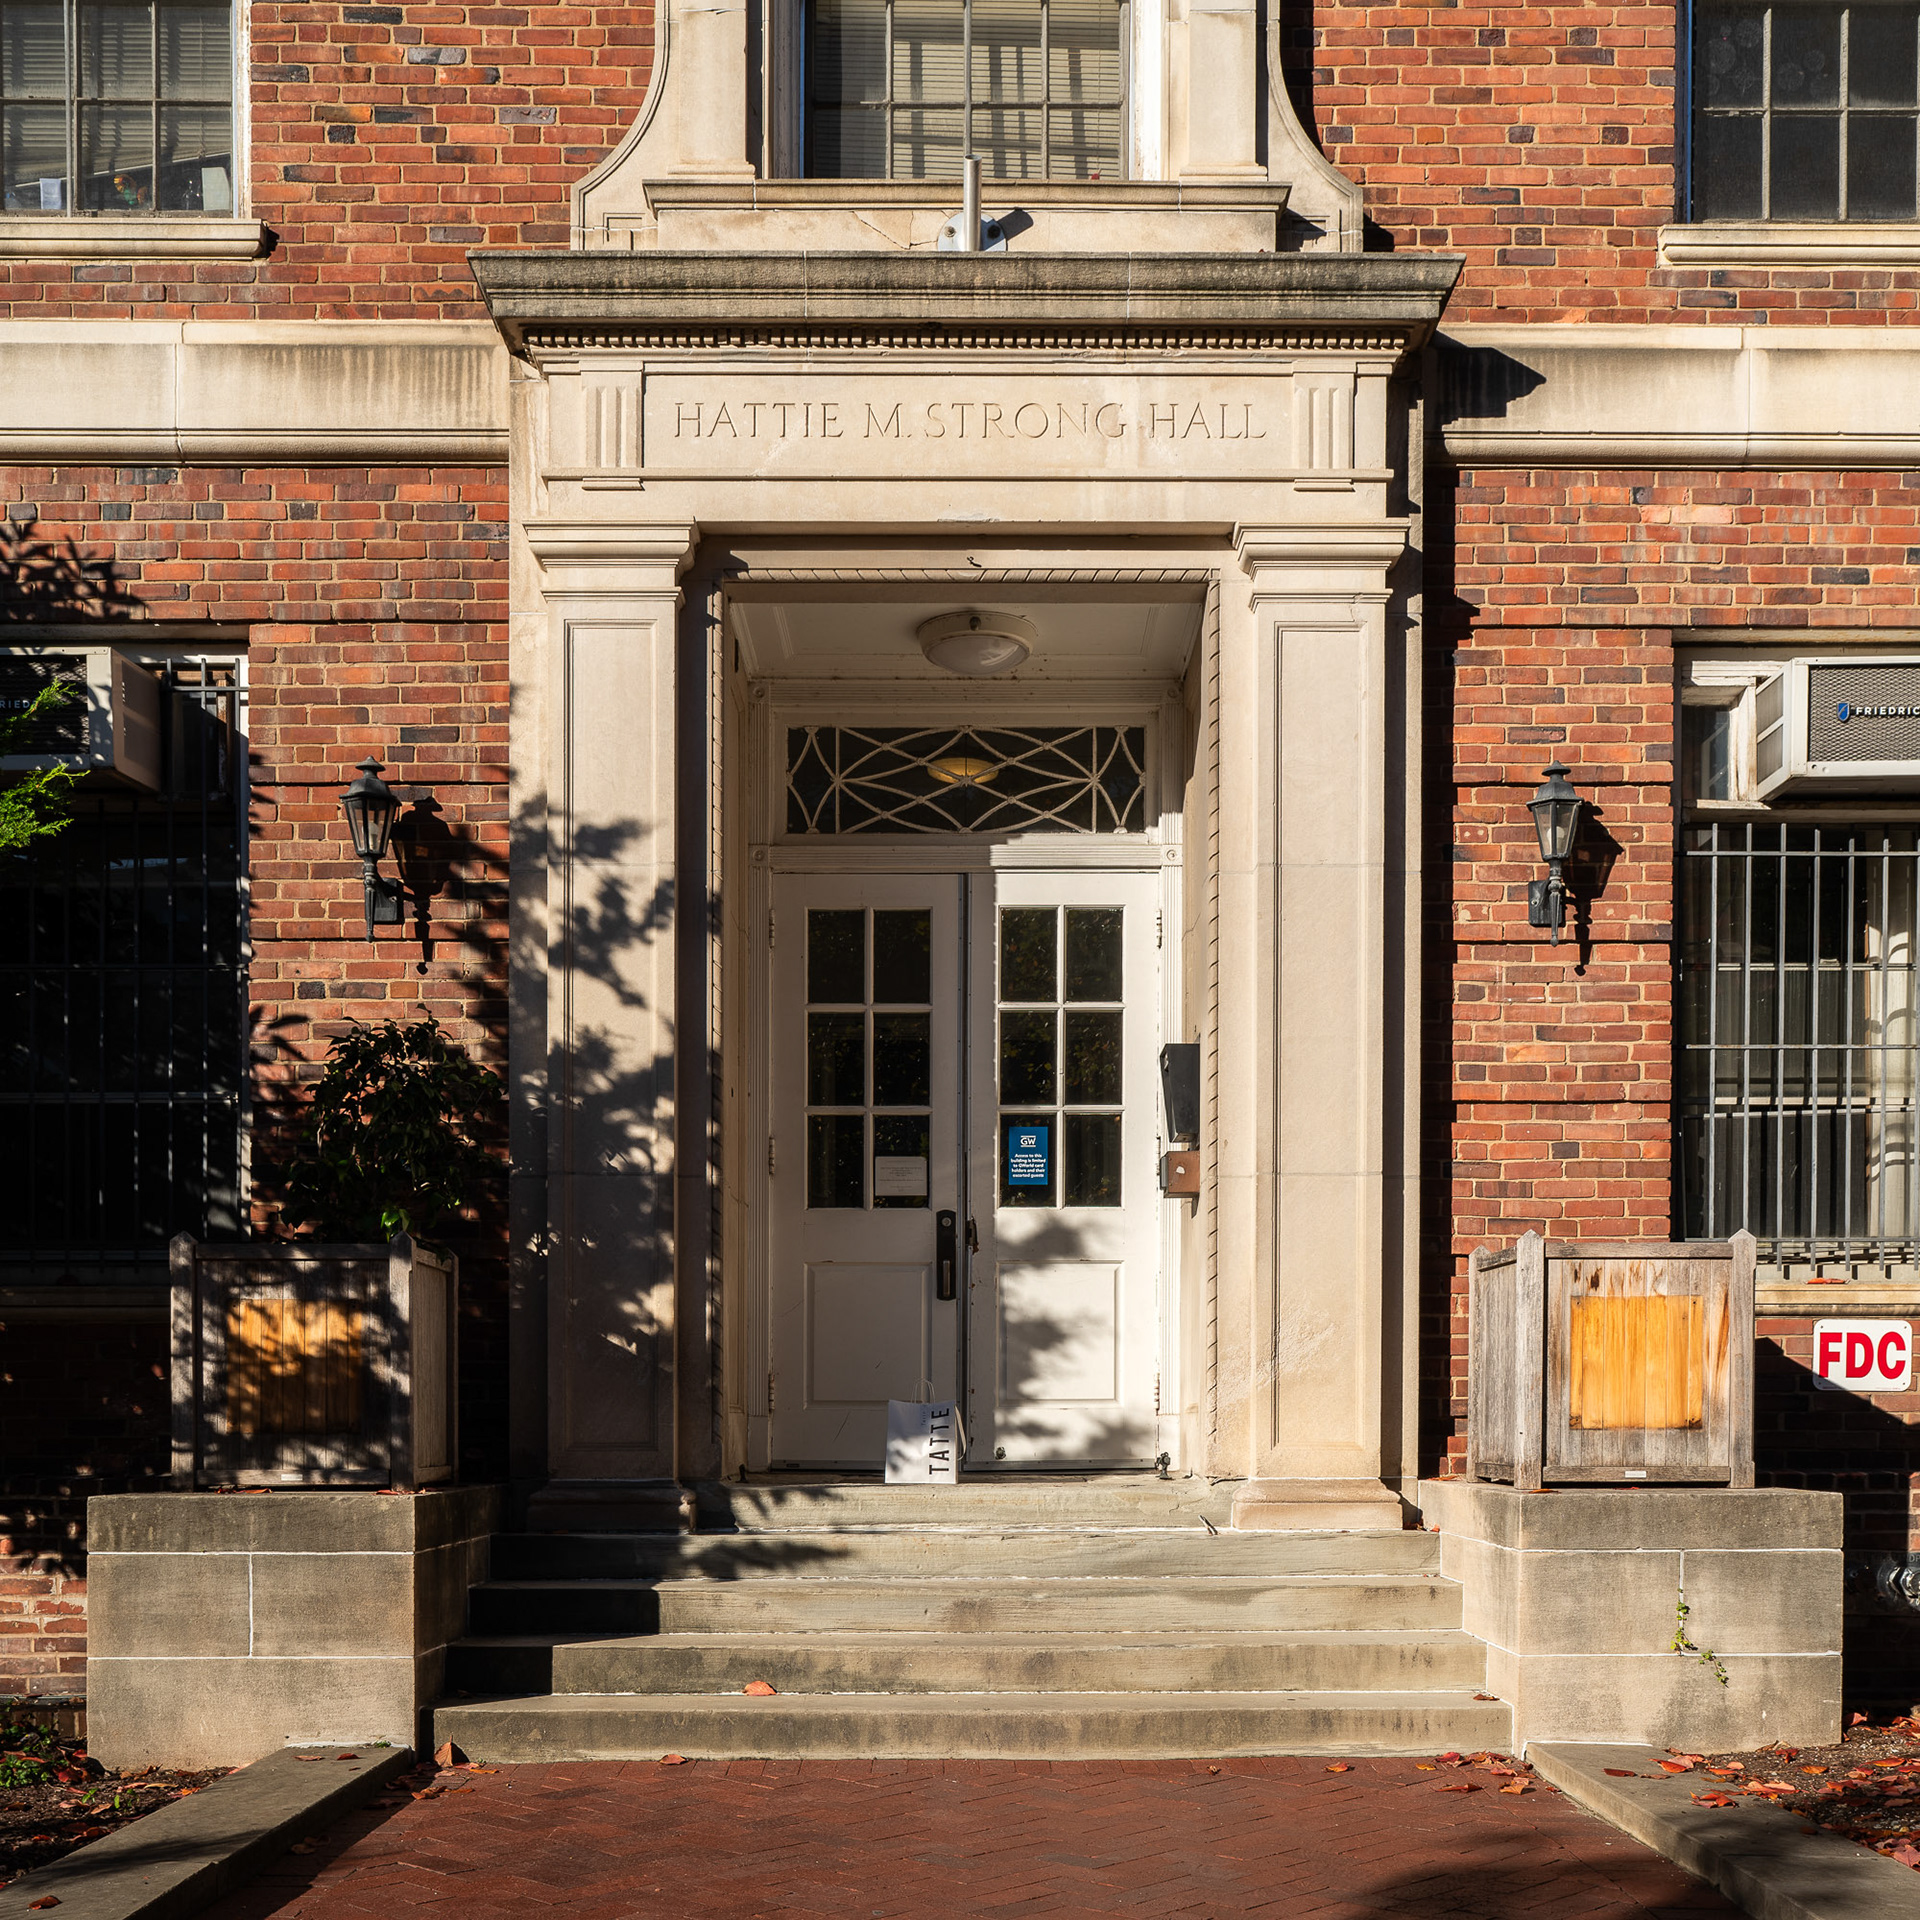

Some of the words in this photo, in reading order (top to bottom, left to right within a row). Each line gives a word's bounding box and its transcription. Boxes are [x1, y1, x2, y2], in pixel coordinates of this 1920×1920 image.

[674, 402, 844, 438] HATTIE
[863, 402, 911, 438] M.
[924, 402, 1127, 438] STRONG
[1149, 402, 1267, 438] HALL
[1020, 1137, 1036, 1145] GW
[1819, 1331, 1906, 1379] FDC
[929, 1408, 950, 1475] TATTE
